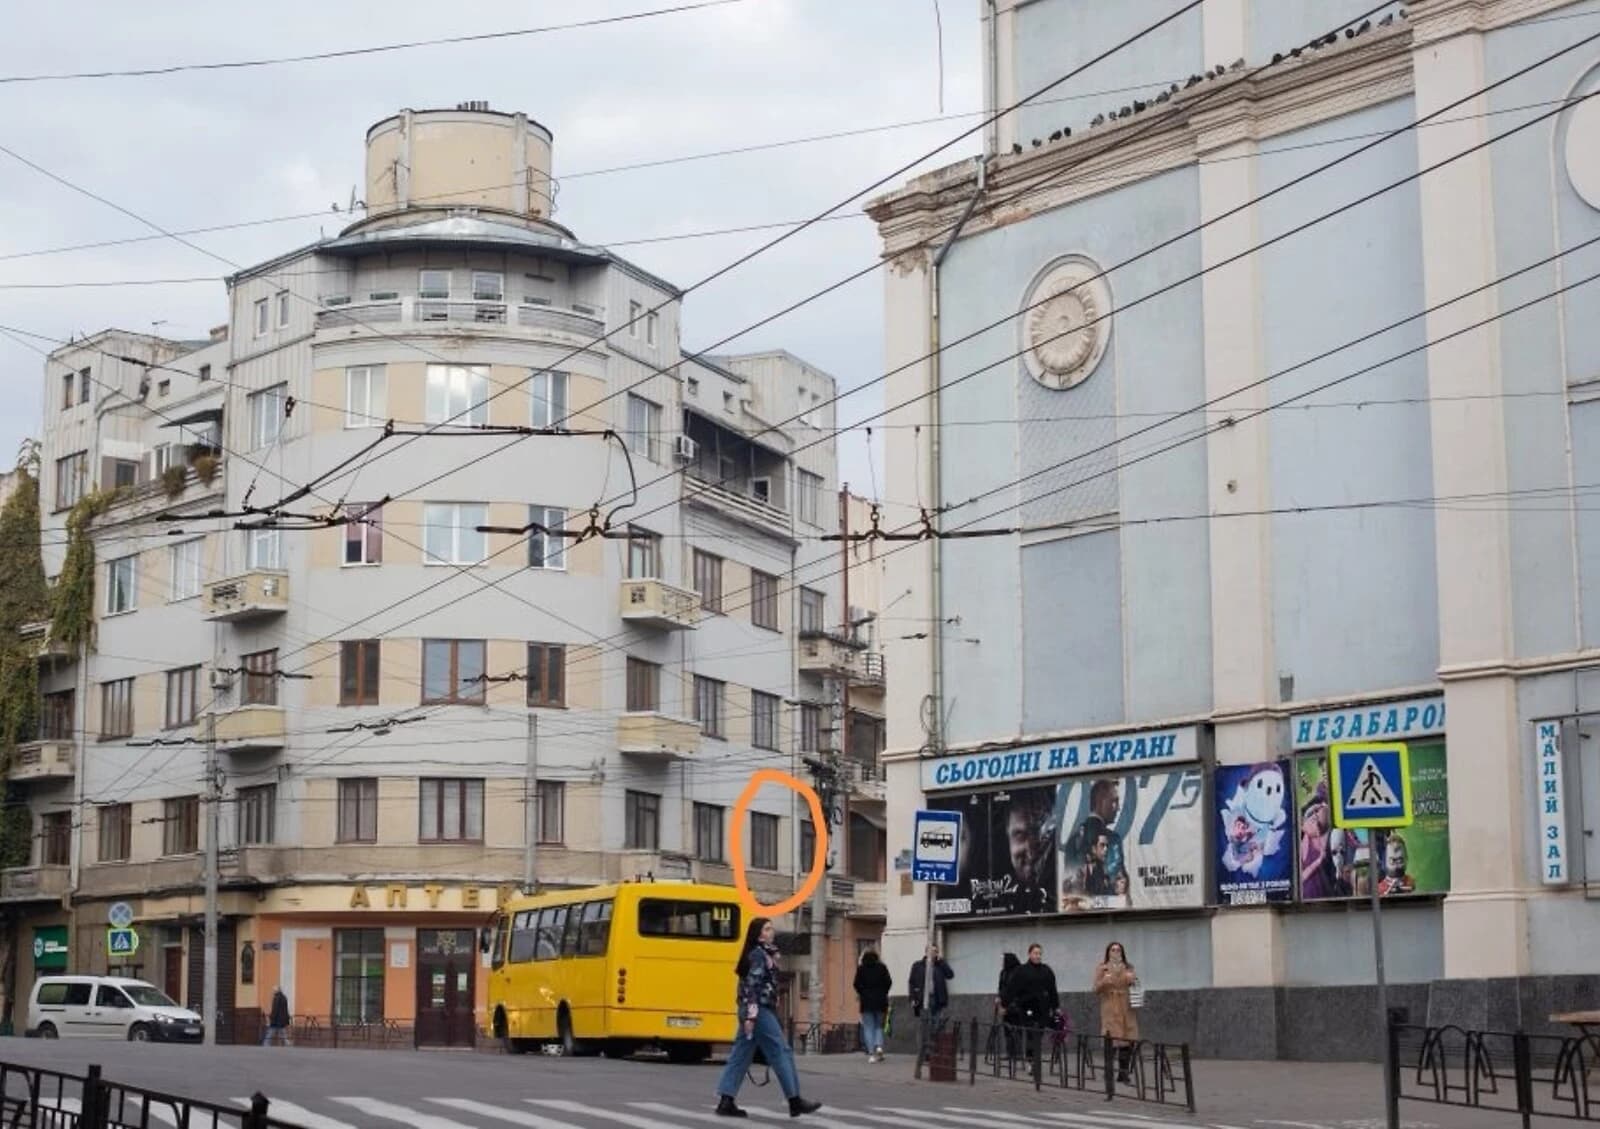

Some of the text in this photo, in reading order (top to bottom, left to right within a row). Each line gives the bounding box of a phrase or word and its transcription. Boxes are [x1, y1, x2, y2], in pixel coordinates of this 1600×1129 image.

[936, 734, 1177, 786] СЬОГОДНІ НА ЕКРАНІ
[1540, 724, 1561, 878] МАЛИЙ ЗАЛ
